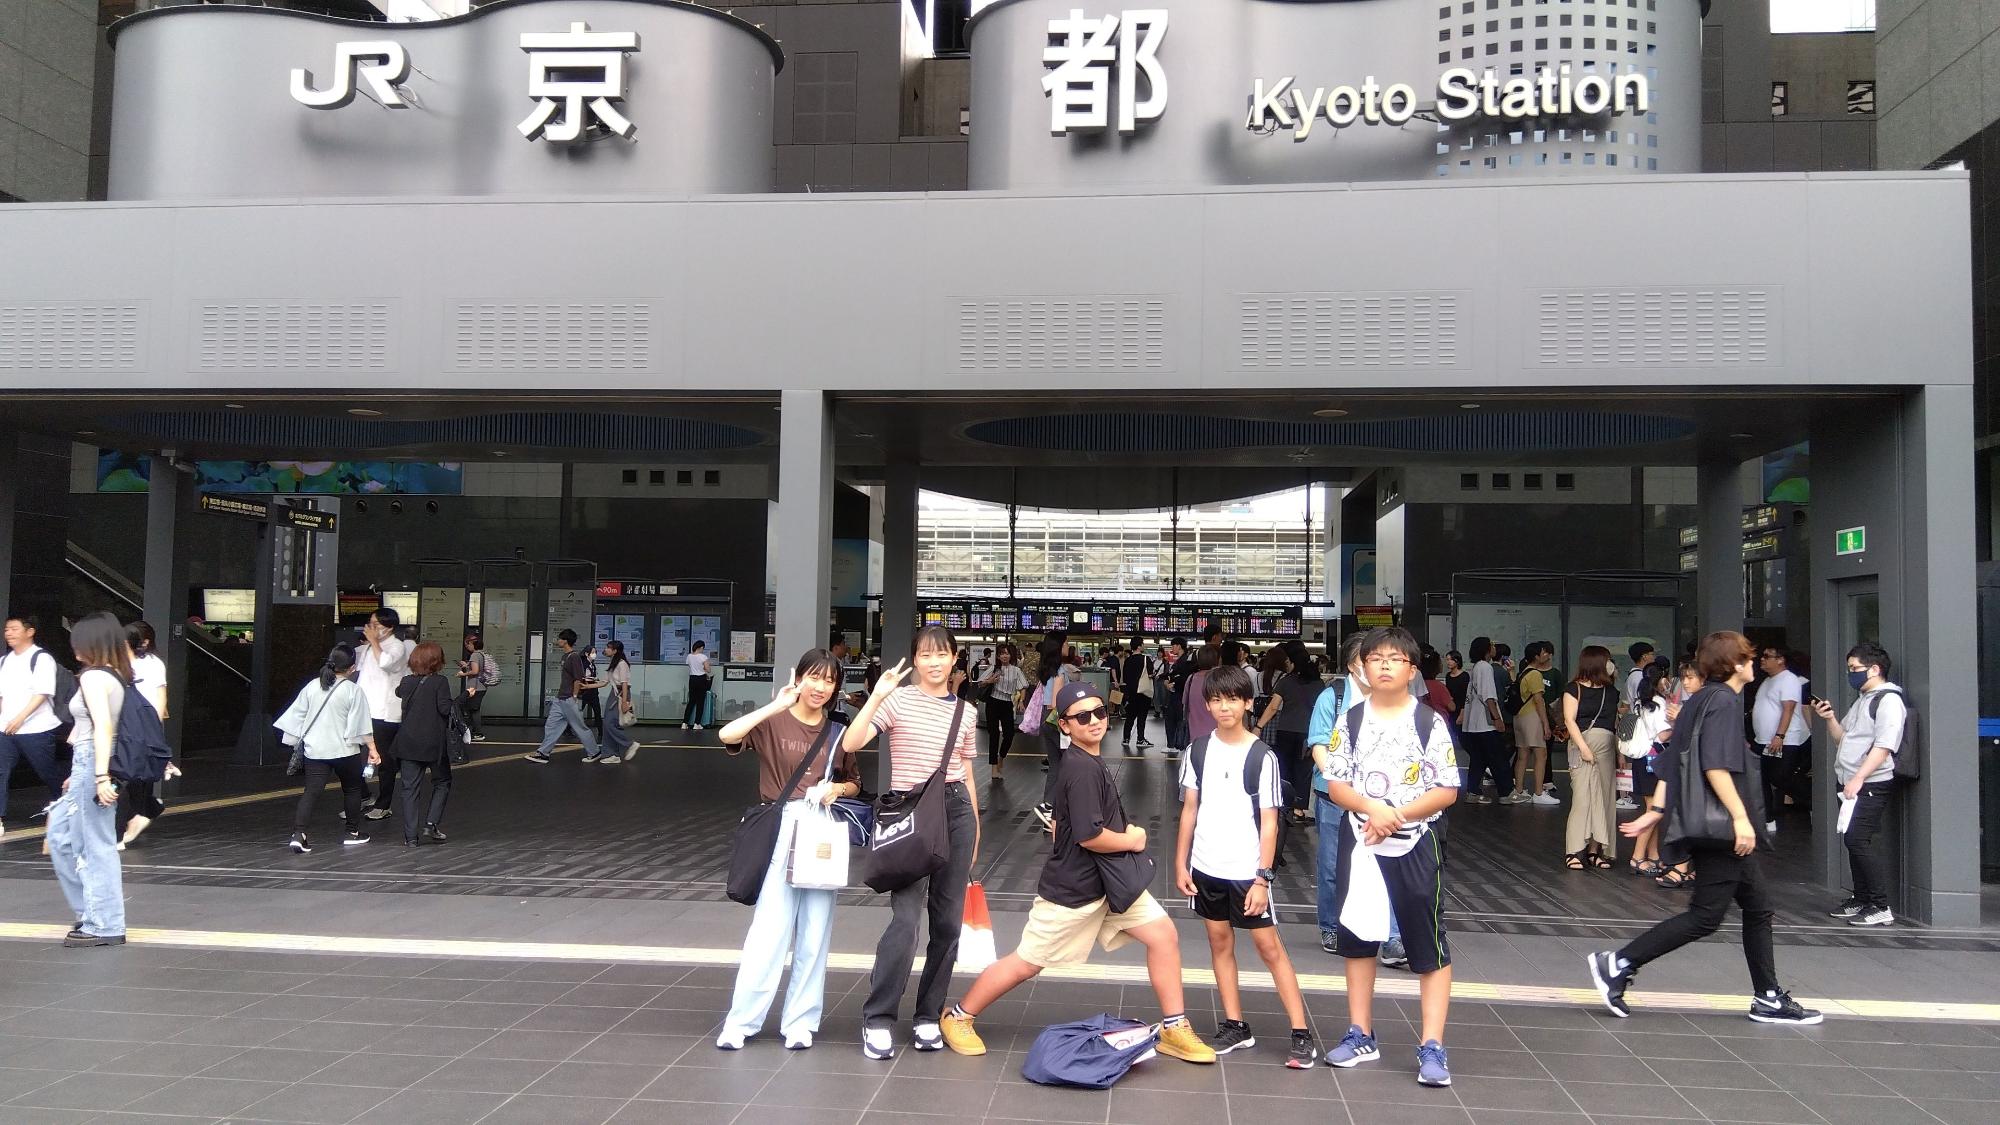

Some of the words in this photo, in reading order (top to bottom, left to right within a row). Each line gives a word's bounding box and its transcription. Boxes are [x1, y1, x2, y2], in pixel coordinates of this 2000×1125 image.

[290, 41, 411, 110] JR
[517, 21, 641, 142] 京
[1041, 9, 1168, 137] 都
[1252, 75, 1416, 143] Kyoto
[1436, 64, 1648, 120] Station
